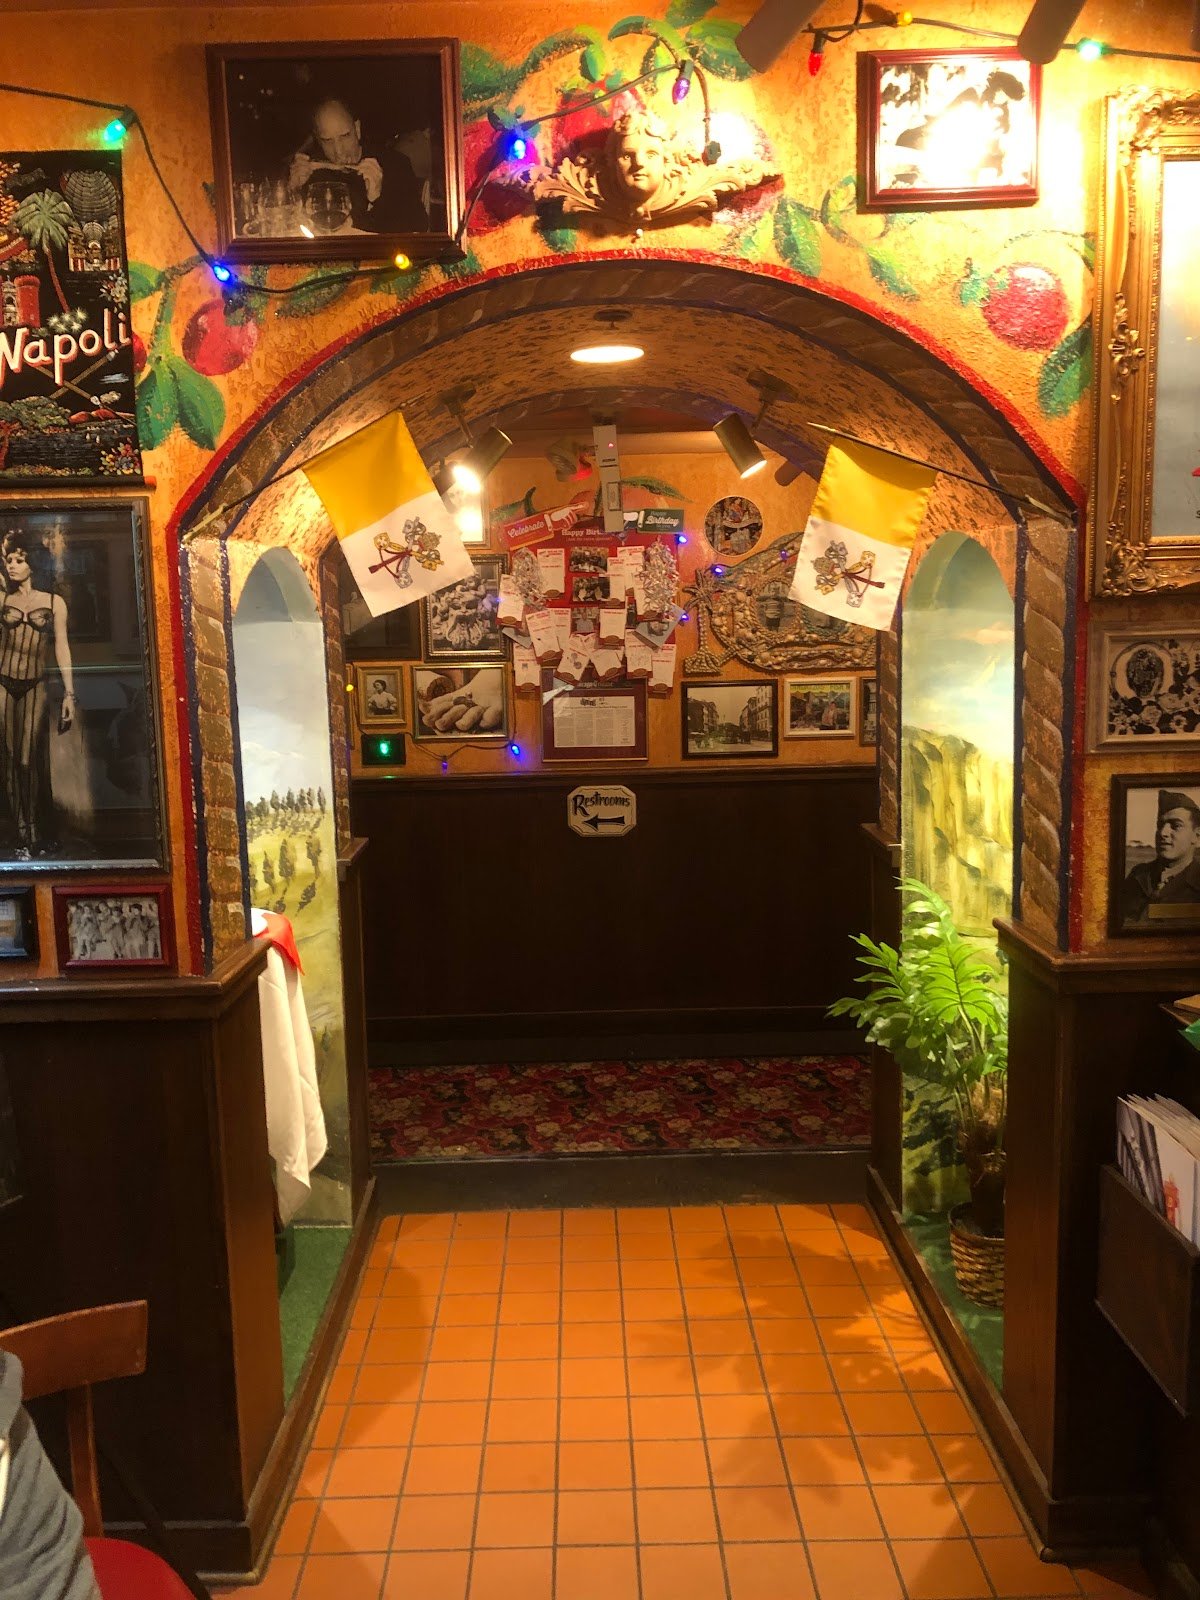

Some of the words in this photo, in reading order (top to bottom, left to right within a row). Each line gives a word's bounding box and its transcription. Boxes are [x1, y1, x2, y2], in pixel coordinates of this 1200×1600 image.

[0, 308, 131, 387] Napoli
[508, 521, 544, 538] Celebrate
[645, 515, 679, 527] Birthday
[562, 529, 584, 537] Happy
[572, 791, 631, 816] Restrooms
